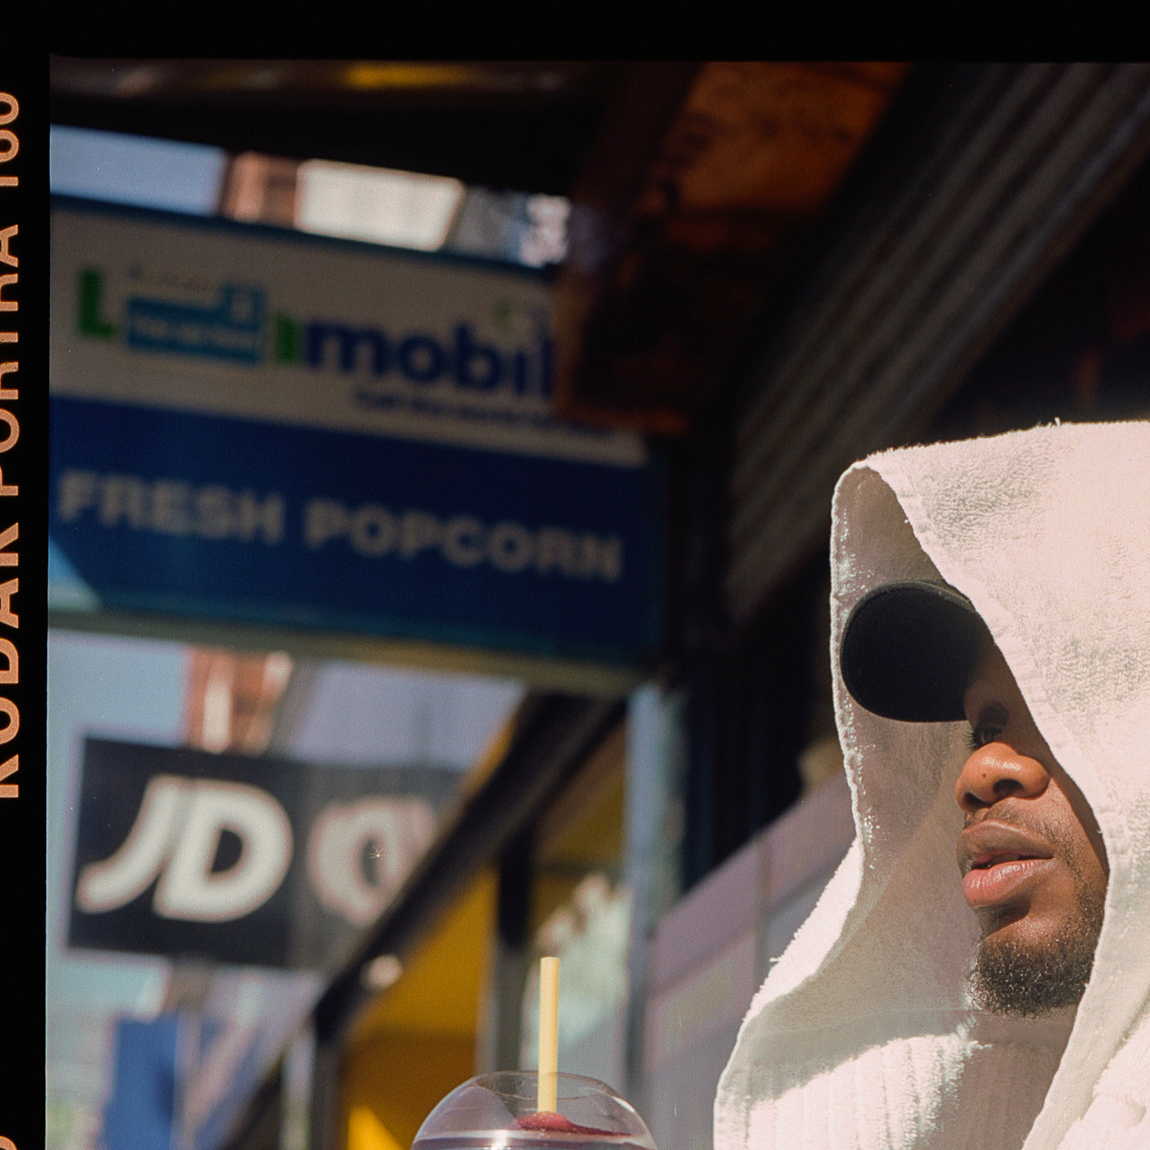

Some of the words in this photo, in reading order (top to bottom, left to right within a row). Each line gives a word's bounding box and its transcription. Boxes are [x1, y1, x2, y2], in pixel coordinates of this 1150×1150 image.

[57, 470, 287, 546] FRESH
[303, 496, 625, 584] POPCORN
[76, 774, 294, 922] JD
